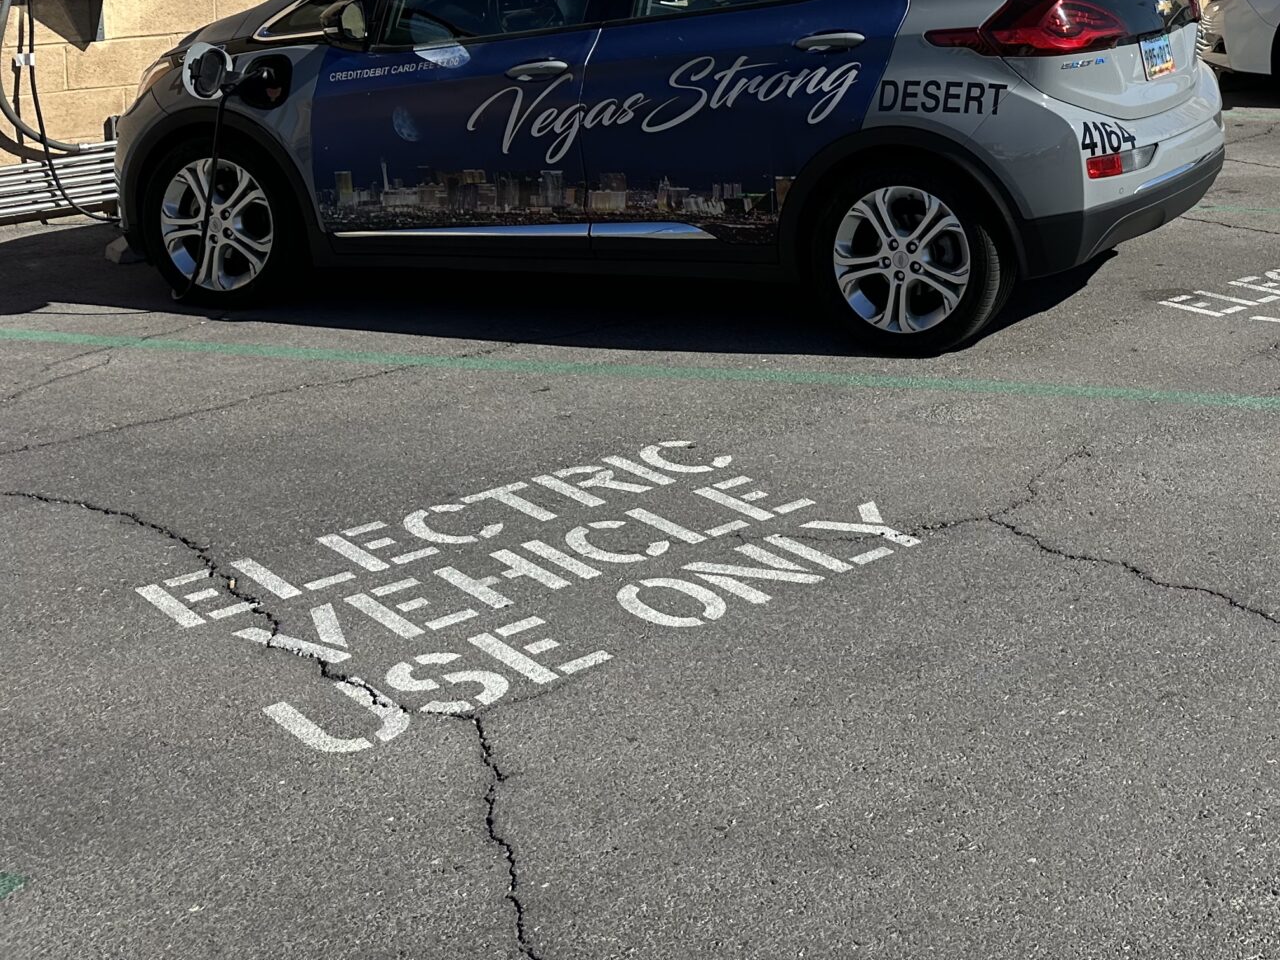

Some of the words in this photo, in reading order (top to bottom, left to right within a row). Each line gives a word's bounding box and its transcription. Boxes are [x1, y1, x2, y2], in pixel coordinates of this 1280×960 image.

[329, 66, 390, 82] CREDIT/DEBIT
[391, 63, 416, 74] CARD
[417, 60, 434, 71] FEE
[466, 73, 652, 165] Vegas
[641, 55, 862, 133] Strong
[878, 79, 1008, 116] DESERT
[1081, 121, 1136, 156] 4164
[135, 440, 734, 628] ELECTRIC
[232, 476, 816, 664] VEHICLE
[261, 616, 614, 754] USE
[616, 501, 921, 628] ONLY
